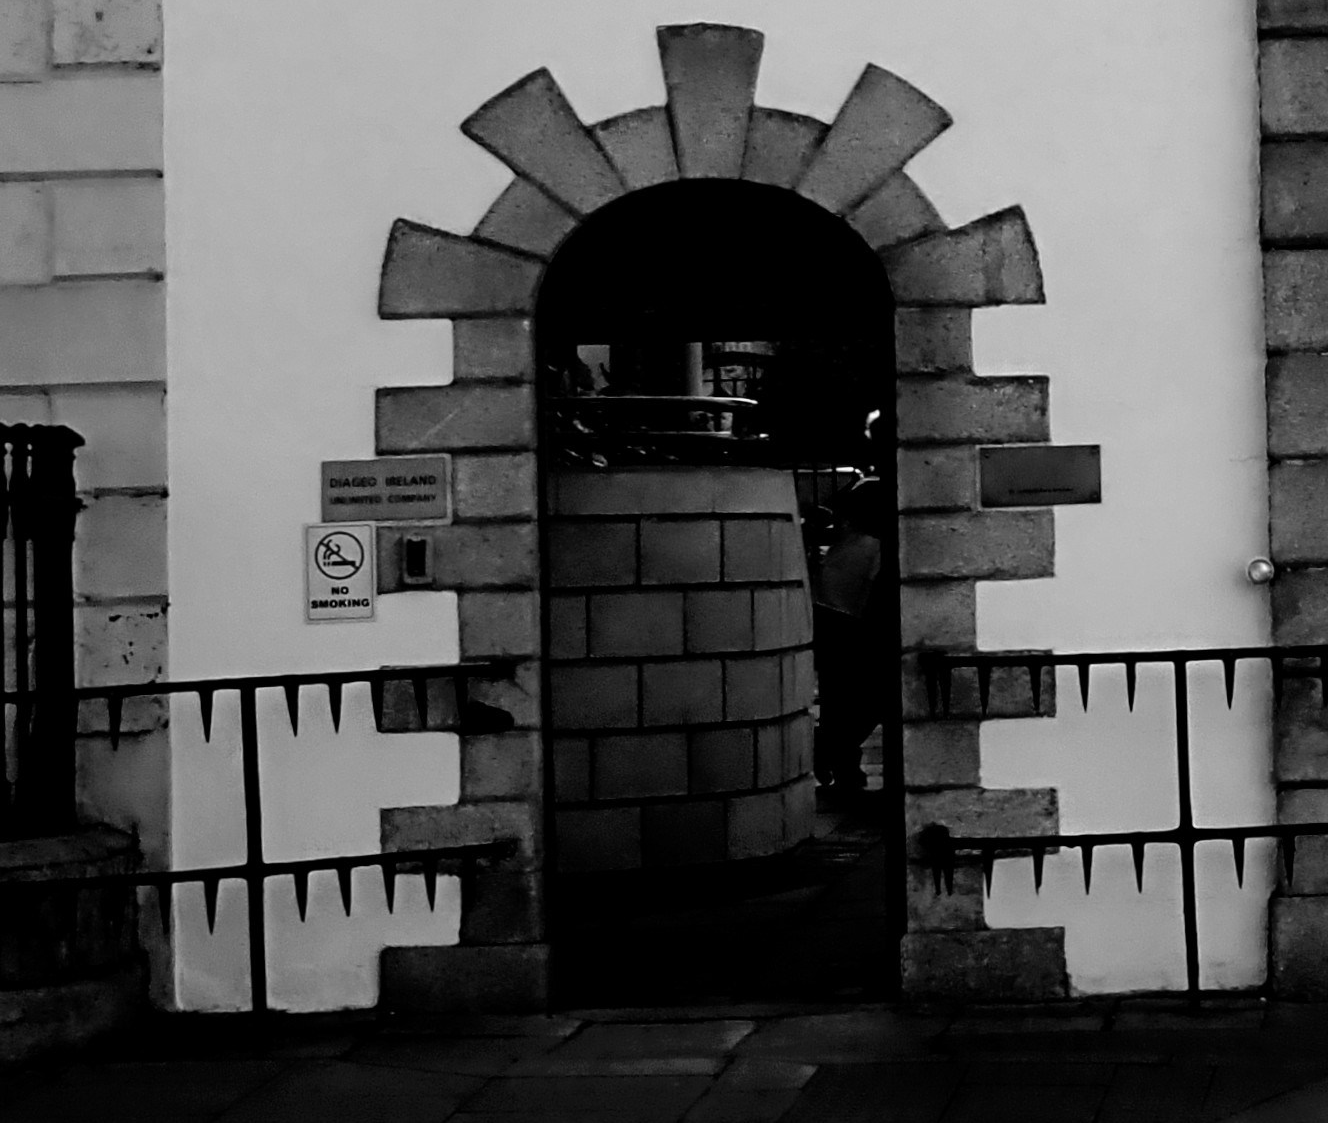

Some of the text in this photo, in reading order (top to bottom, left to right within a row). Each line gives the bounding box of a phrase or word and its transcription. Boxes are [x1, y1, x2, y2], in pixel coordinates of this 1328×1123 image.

[329, 475, 437, 488] DIAGEO IRELAND
[387, 493, 437, 504] COMPANY
[331, 586, 349, 596] NO
[310, 598, 371, 610] SMOKING
